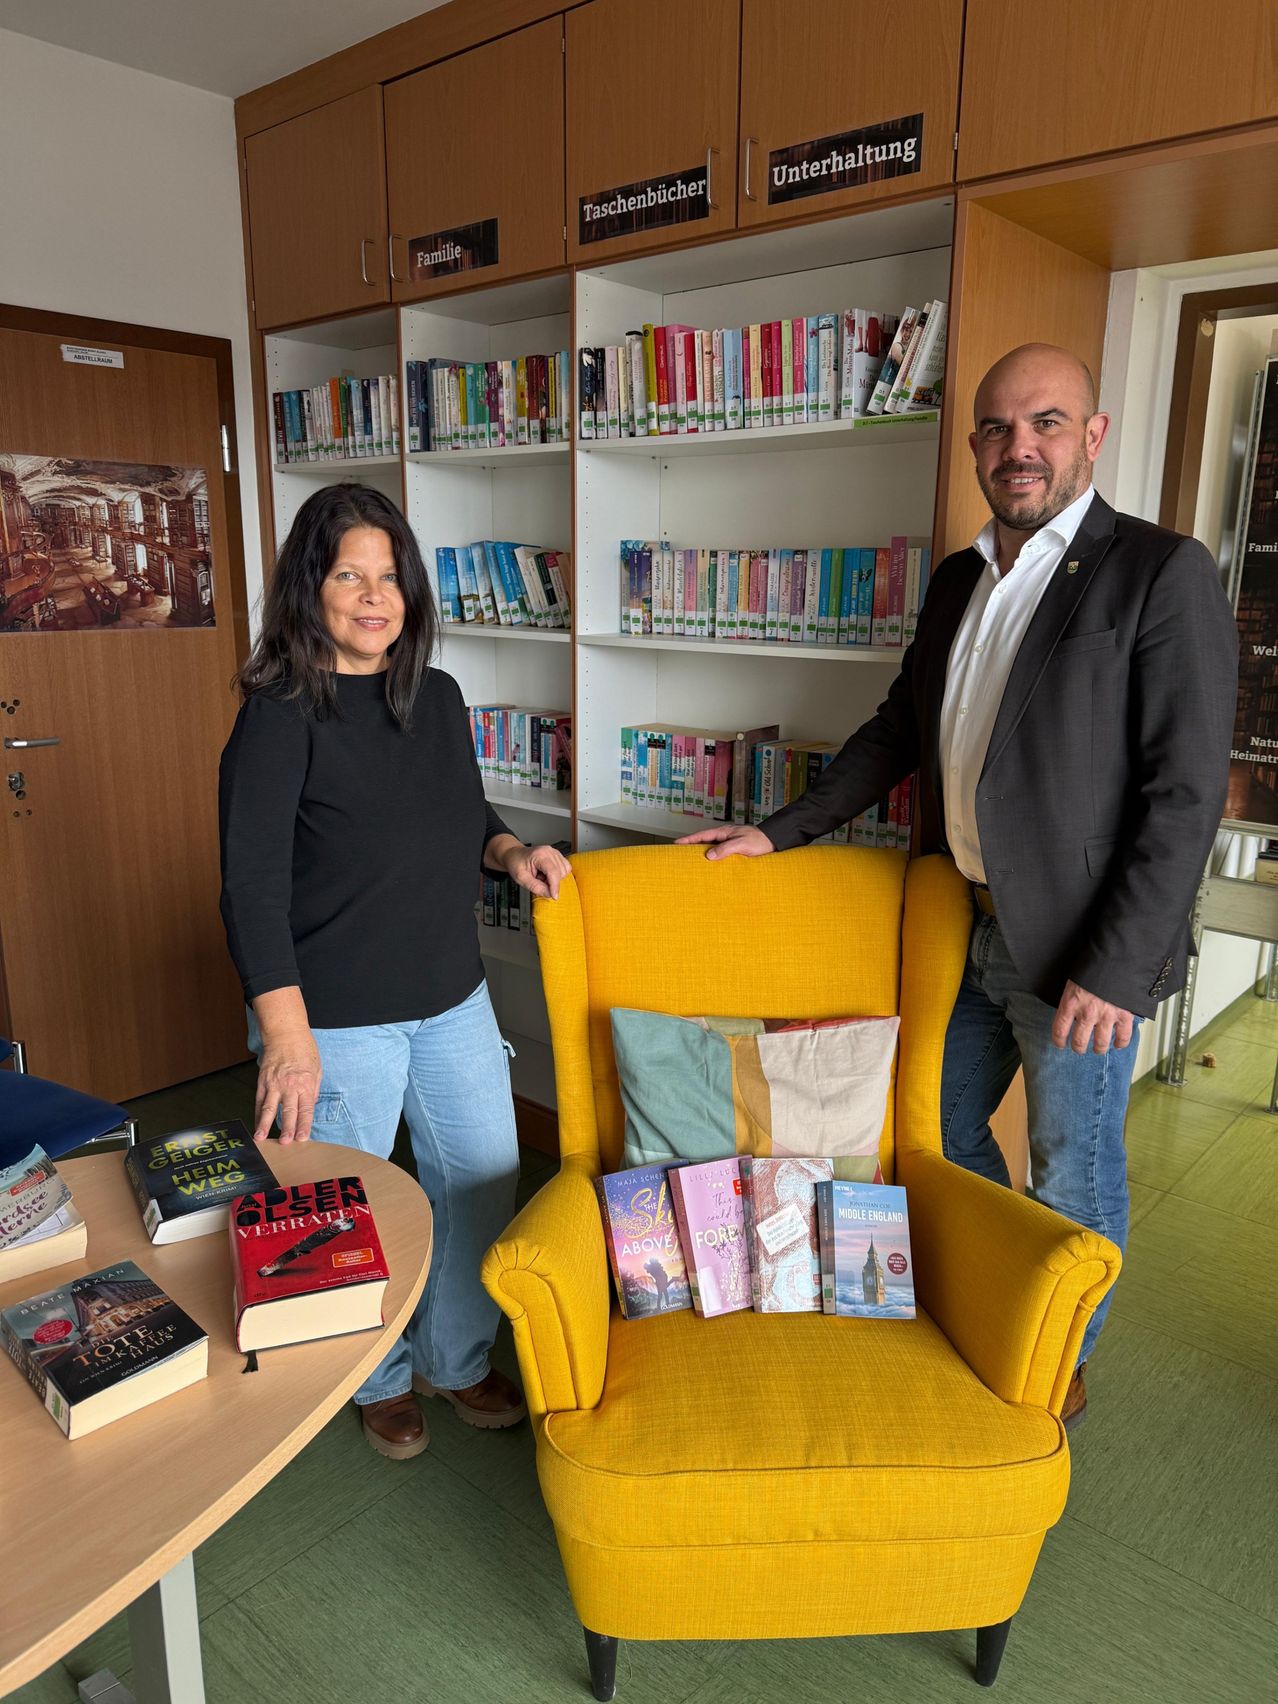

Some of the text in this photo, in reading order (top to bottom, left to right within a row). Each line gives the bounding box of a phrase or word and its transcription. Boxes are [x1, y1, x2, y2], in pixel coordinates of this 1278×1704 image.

[773, 136, 917, 186] Unterhaltung
[583, 178, 706, 222] Taschenbücher
[416, 241, 462, 268] Familie
[73, 354, 113, 364] ABSTELLRAUM
[1252, 645, 1278, 657] Wel
[148, 1138, 245, 1170] GEIGER
[151, 1129, 229, 1158] ERNST
[171, 1159, 240, 1186] HEIM
[178, 1171, 246, 1196] WEG
[617, 1178, 638, 1187] MAJA
[237, 1176, 363, 1213] ADLER
[644, 1202, 658, 1211] THE
[849, 1200, 879, 1208] JONATHAN
[236, 1190, 369, 1227] OLSEN
[237, 1205, 370, 1239] VERRATEN
[838, 1208, 903, 1223] MIDDLE ENGLAND
[621, 1234, 673, 1258] ABOVE
[20, 1268, 125, 1316] BEATE MAXIAN
[73, 1325, 153, 1367] TOTE
[95, 1324, 177, 1367] IM KAFFEE
[130, 1333, 174, 1359] HAUS
[121, 1355, 159, 1376] GOLDMANN
